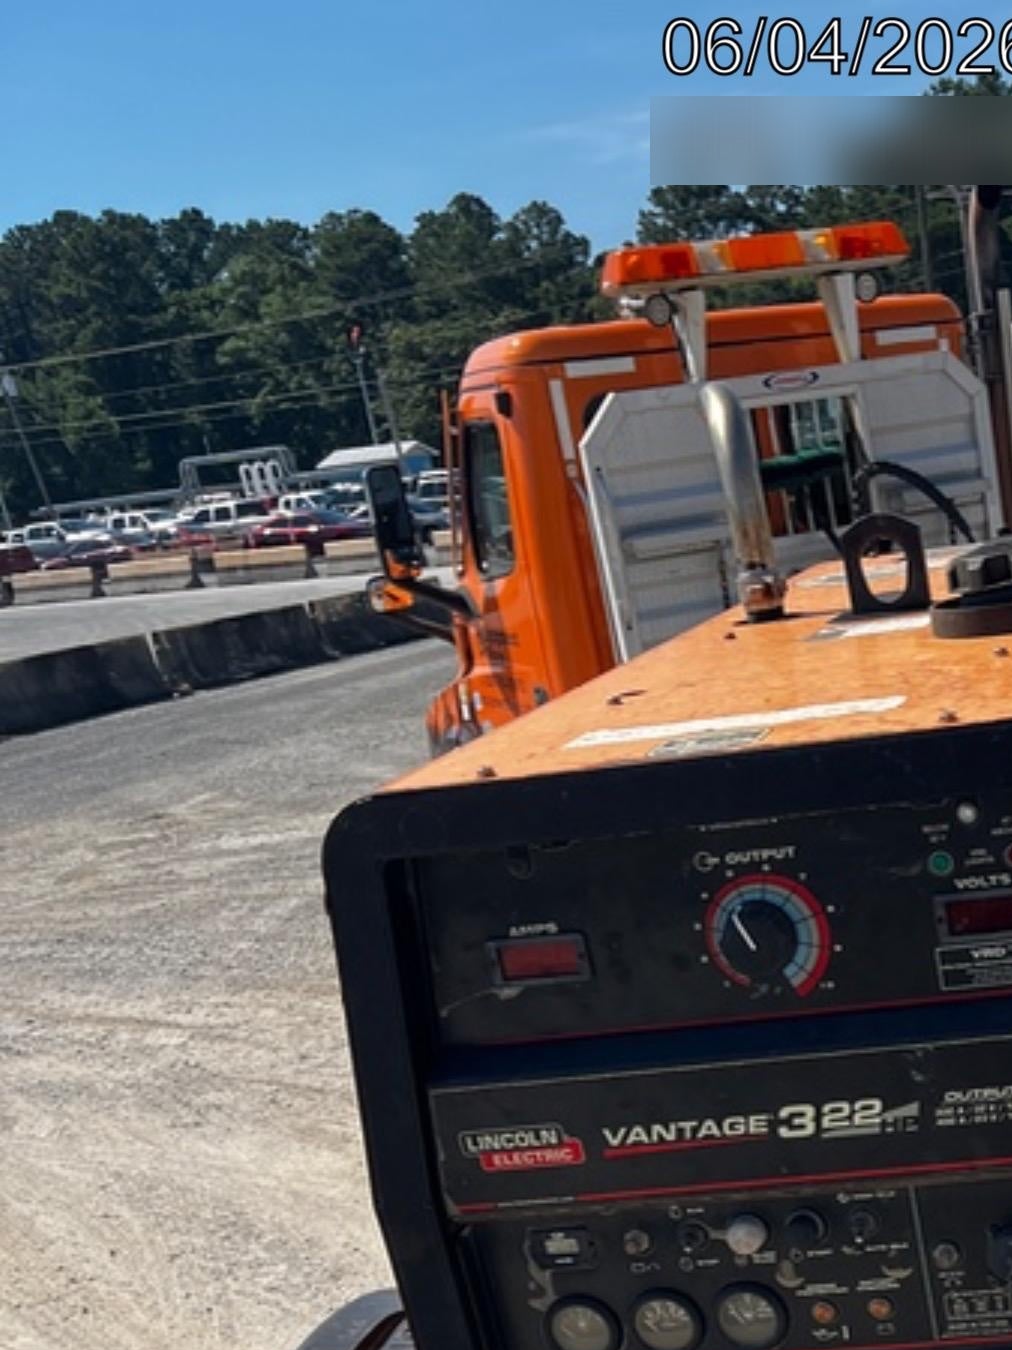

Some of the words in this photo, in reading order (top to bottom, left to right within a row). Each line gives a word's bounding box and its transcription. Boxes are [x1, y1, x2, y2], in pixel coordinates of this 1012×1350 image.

[724, 845, 797, 865] OUTPUT
[953, 872, 1012, 890] VOLTS
[601, 1114, 769, 1148] VANTAGE
[777, 1097, 884, 1139] 322
[463, 1127, 559, 1152] LINCOLN
[491, 1147, 576, 1168] ELECTRIC
